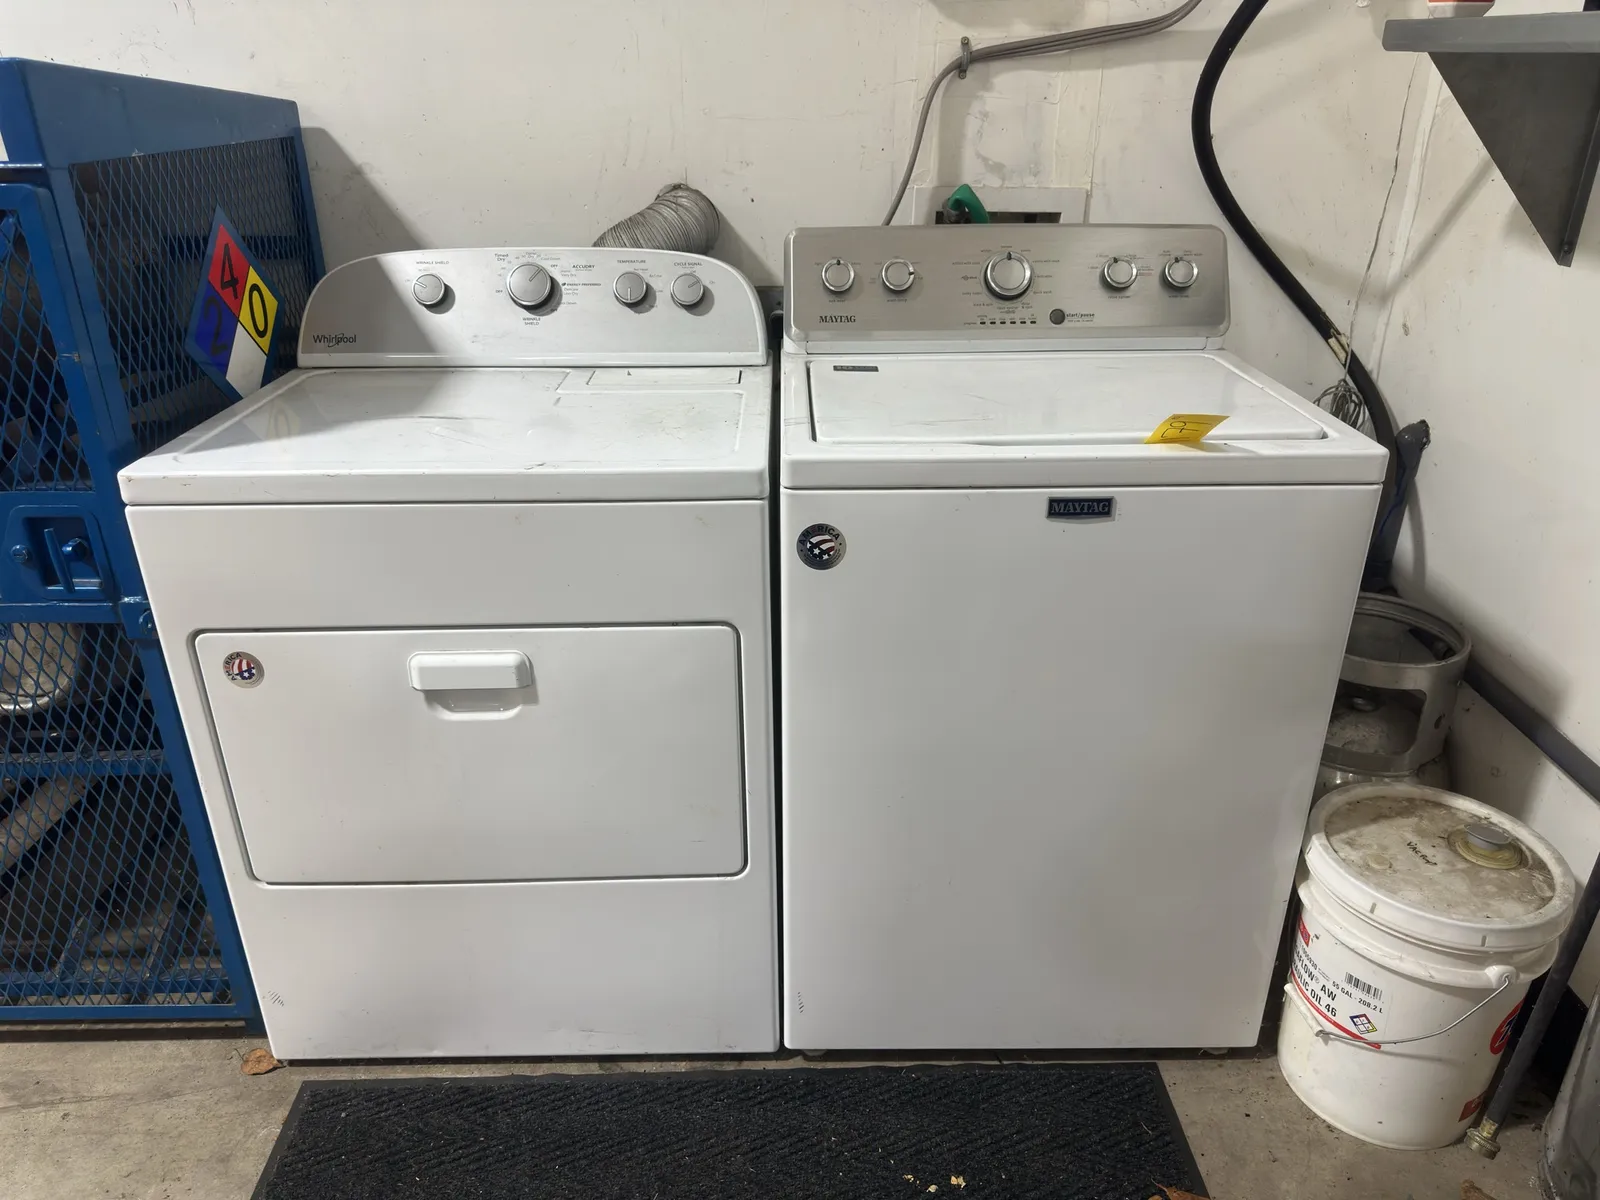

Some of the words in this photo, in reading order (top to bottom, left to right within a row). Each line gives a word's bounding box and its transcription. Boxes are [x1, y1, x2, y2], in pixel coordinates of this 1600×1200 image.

[220, 243, 239, 299] 4
[248, 283, 269, 339] 0
[819, 315, 856, 323] MAYTAG
[204, 295, 229, 357] 2
[313, 333, 357, 347] Whirlpool
[1051, 502, 1109, 513] MAYTAG
[1310, 988, 1323, 1007] OIL
[1324, 1003, 1337, 1018] 46
[1320, 984, 1337, 1002] AW
[1340, 987, 1353, 999] GAL
[1358, 997, 1378, 1011] 208.2
